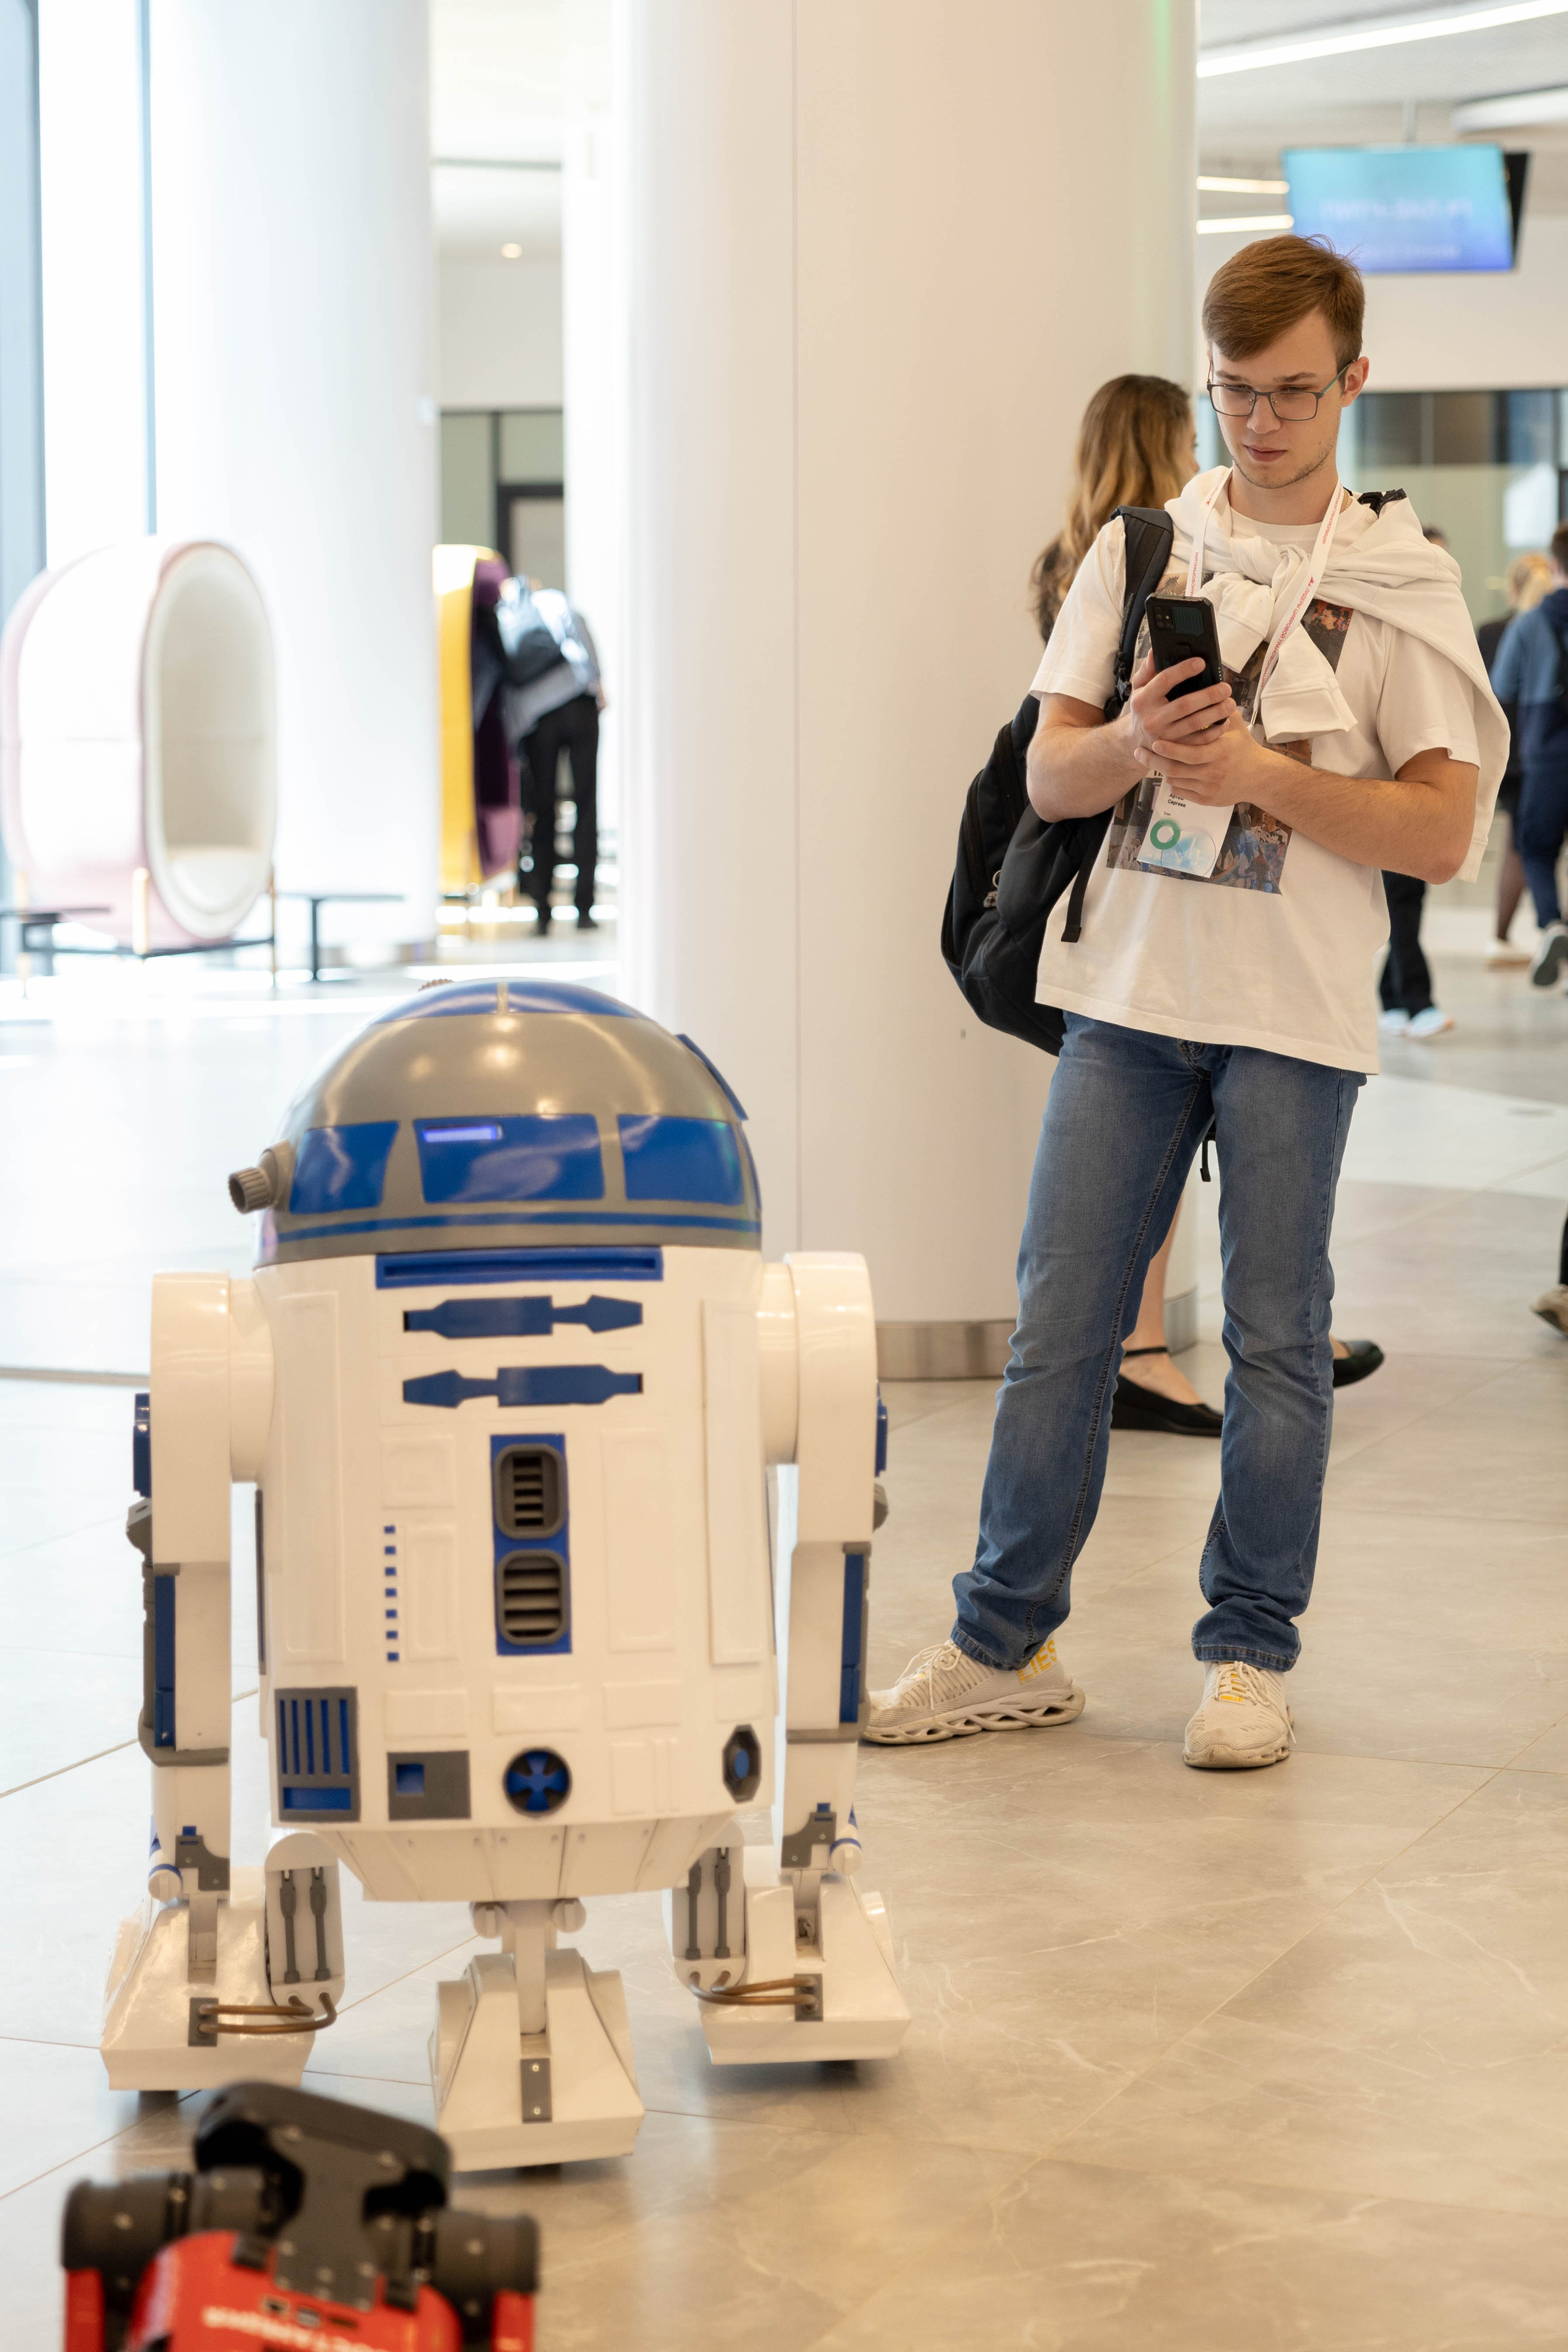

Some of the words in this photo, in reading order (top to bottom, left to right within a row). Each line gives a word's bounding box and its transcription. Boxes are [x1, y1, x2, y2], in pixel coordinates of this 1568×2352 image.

[1189, 552, 1199, 597] РАНСФОРМАЦИИ
[1297, 587, 1310, 609] ЛИДЕРЫ
[1280, 608, 1299, 639] ЦИФРОВОЙ
[1261, 638, 1283, 688] ТРАНСФОРМАЦИИ
[1167, 799, 1186, 807] Сергеев
